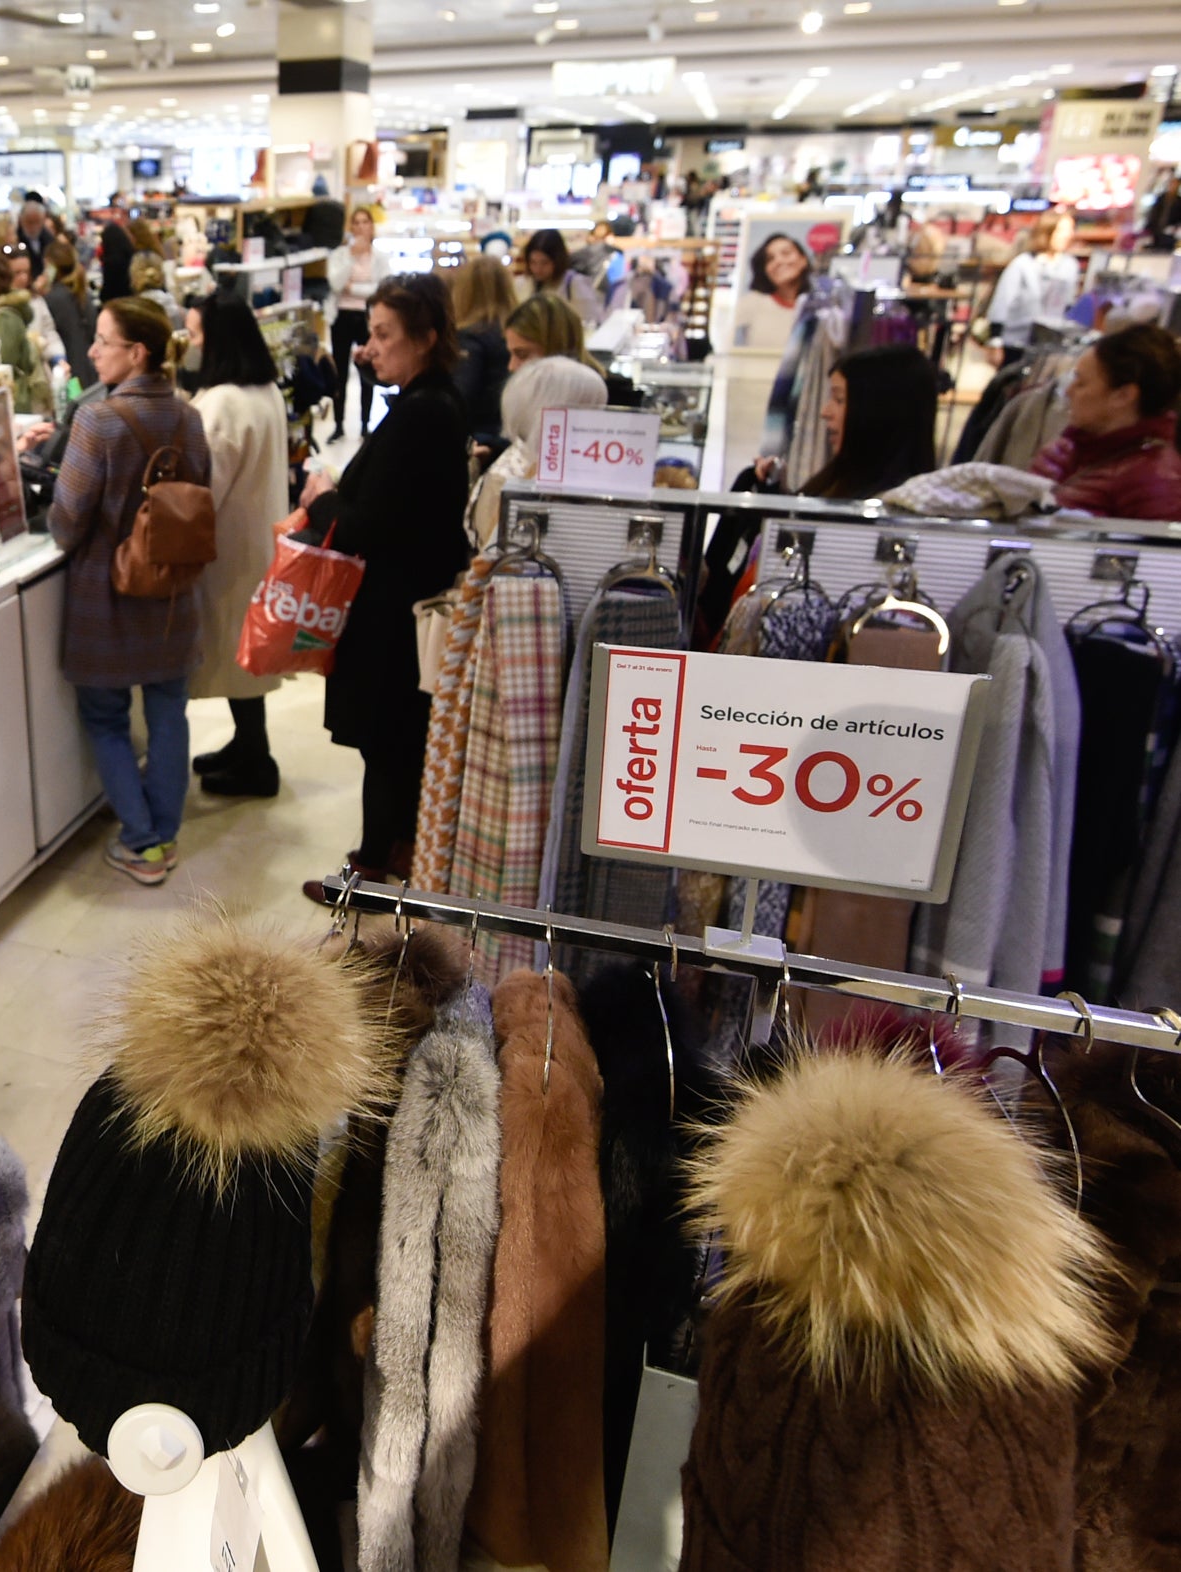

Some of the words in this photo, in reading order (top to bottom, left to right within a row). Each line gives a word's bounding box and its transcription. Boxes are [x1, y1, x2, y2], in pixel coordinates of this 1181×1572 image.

[545, 424, 561, 471] oferta
[570, 440, 644, 466] -40%
[700, 705, 803, 728] Selección
[810, 714, 839, 731] de
[845, 719, 945, 741] artículos
[616, 697, 662, 821] oferta
[696, 744, 717, 753] Hasta
[696, 743, 923, 822] -30%
[688, 818, 708, 826] Precio
[709, 820, 722, 828] final
[722, 823, 750, 832] marcado
